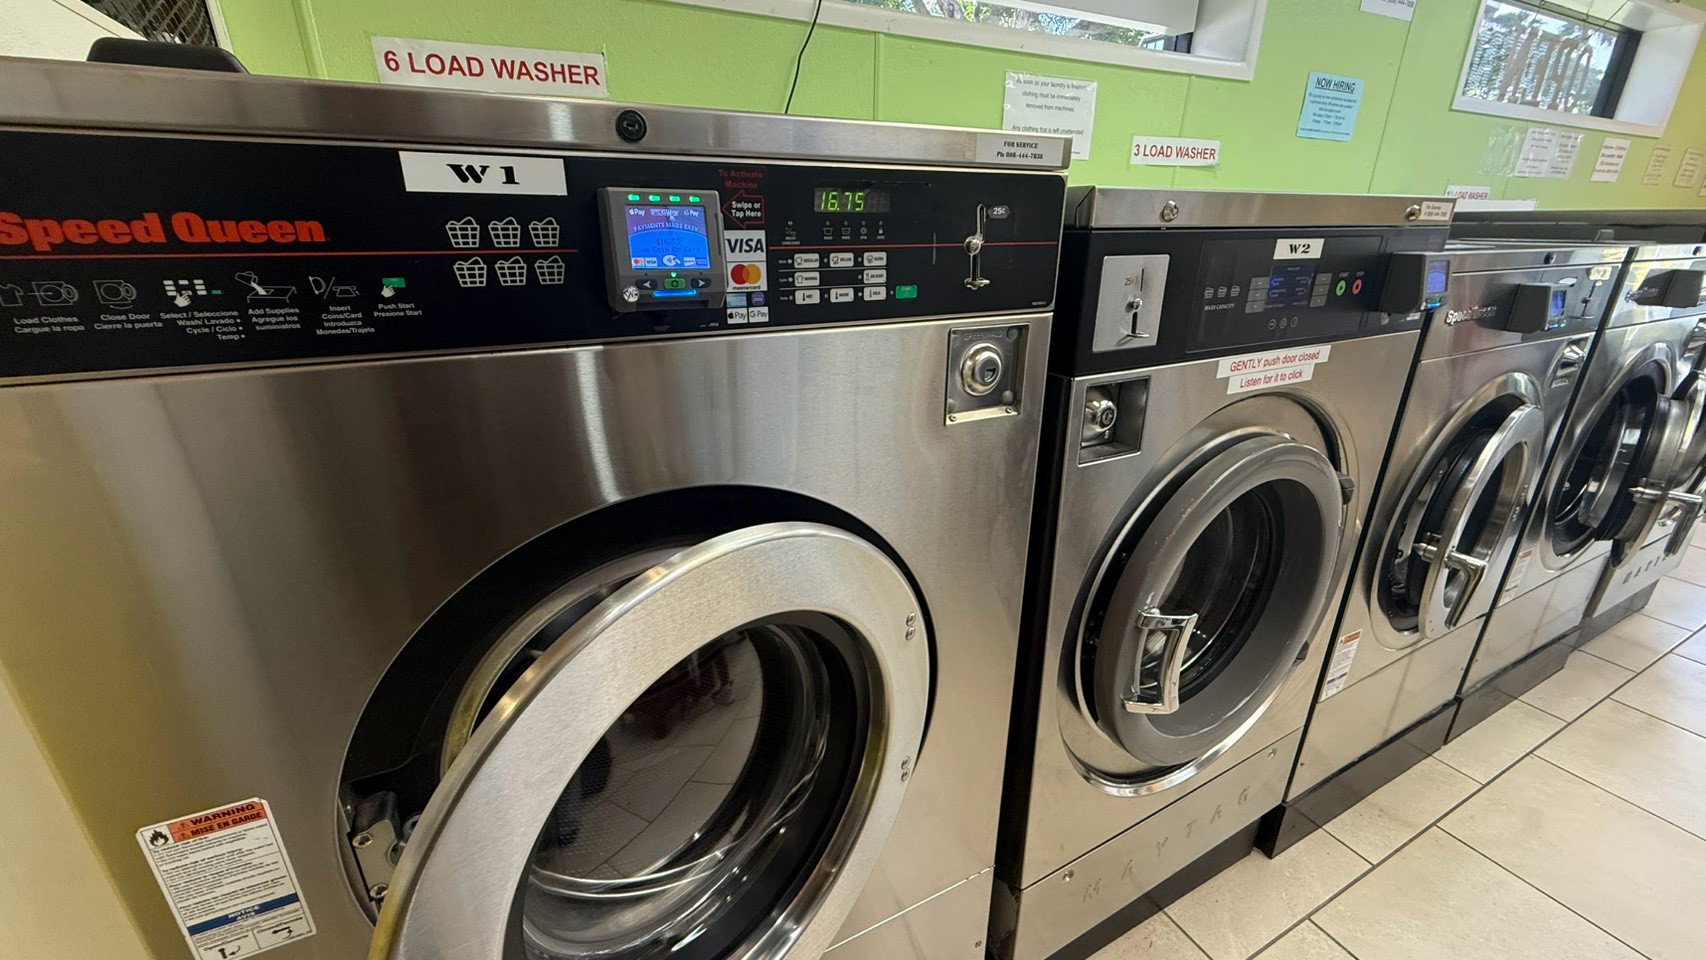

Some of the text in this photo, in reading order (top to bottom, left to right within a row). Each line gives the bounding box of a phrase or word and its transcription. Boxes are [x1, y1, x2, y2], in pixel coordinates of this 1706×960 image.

[383, 50, 600, 86] 6 LOAD WASHER
[1315, 76, 1356, 93] NOW HIRING
[1003, 140, 1039, 149] FOR SERVICE
[1133, 144, 1216, 160] 3 LOAD WASHER
[446, 163, 520, 185] W 1
[718, 169, 763, 179] To Activate
[725, 181, 758, 189] Machine
[731, 200, 752, 210] Swipe
[821, 191, 864, 211] 16.75
[731, 210, 762, 218] Tap Here
[0, 211, 326, 251] Speed Queen
[633, 221, 700, 232] PAYMENTS MADE EASY
[725, 238, 764, 253] VISA
[1288, 243, 1311, 254] W2
[100, 312, 151, 321] Close Door
[160, 312, 187, 320] Select
[193, 309, 239, 318] Seleccione
[265, 307, 300, 316] Supplies
[321, 312, 363, 320] Coins/Card
[373, 309, 423, 318] Presione Start
[734, 311, 747, 321] Pay
[756, 310, 769, 319] Pay
[13, 315, 79, 326] Load Clothes
[204, 317, 235, 326] Lavado
[251, 314, 299, 324] Agregue los
[323, 319, 363, 327] Introduzca
[14, 324, 86, 335] Cargue la ropa
[94, 321, 163, 330] Cierre la puerta
[186, 326, 210, 335] Cycle
[255, 323, 302, 331] suministros
[216, 333, 240, 341] Temp
[1230, 350, 1321, 373] GENTLY push door closed
[1240, 369, 1303, 389] Listen for it to click
[190, 803, 256, 827] WARNING
[190, 811, 263, 838] MISE EN GARDE
[228, 904, 261, 919] NOTICE
[235, 911, 257, 922] AVIS
